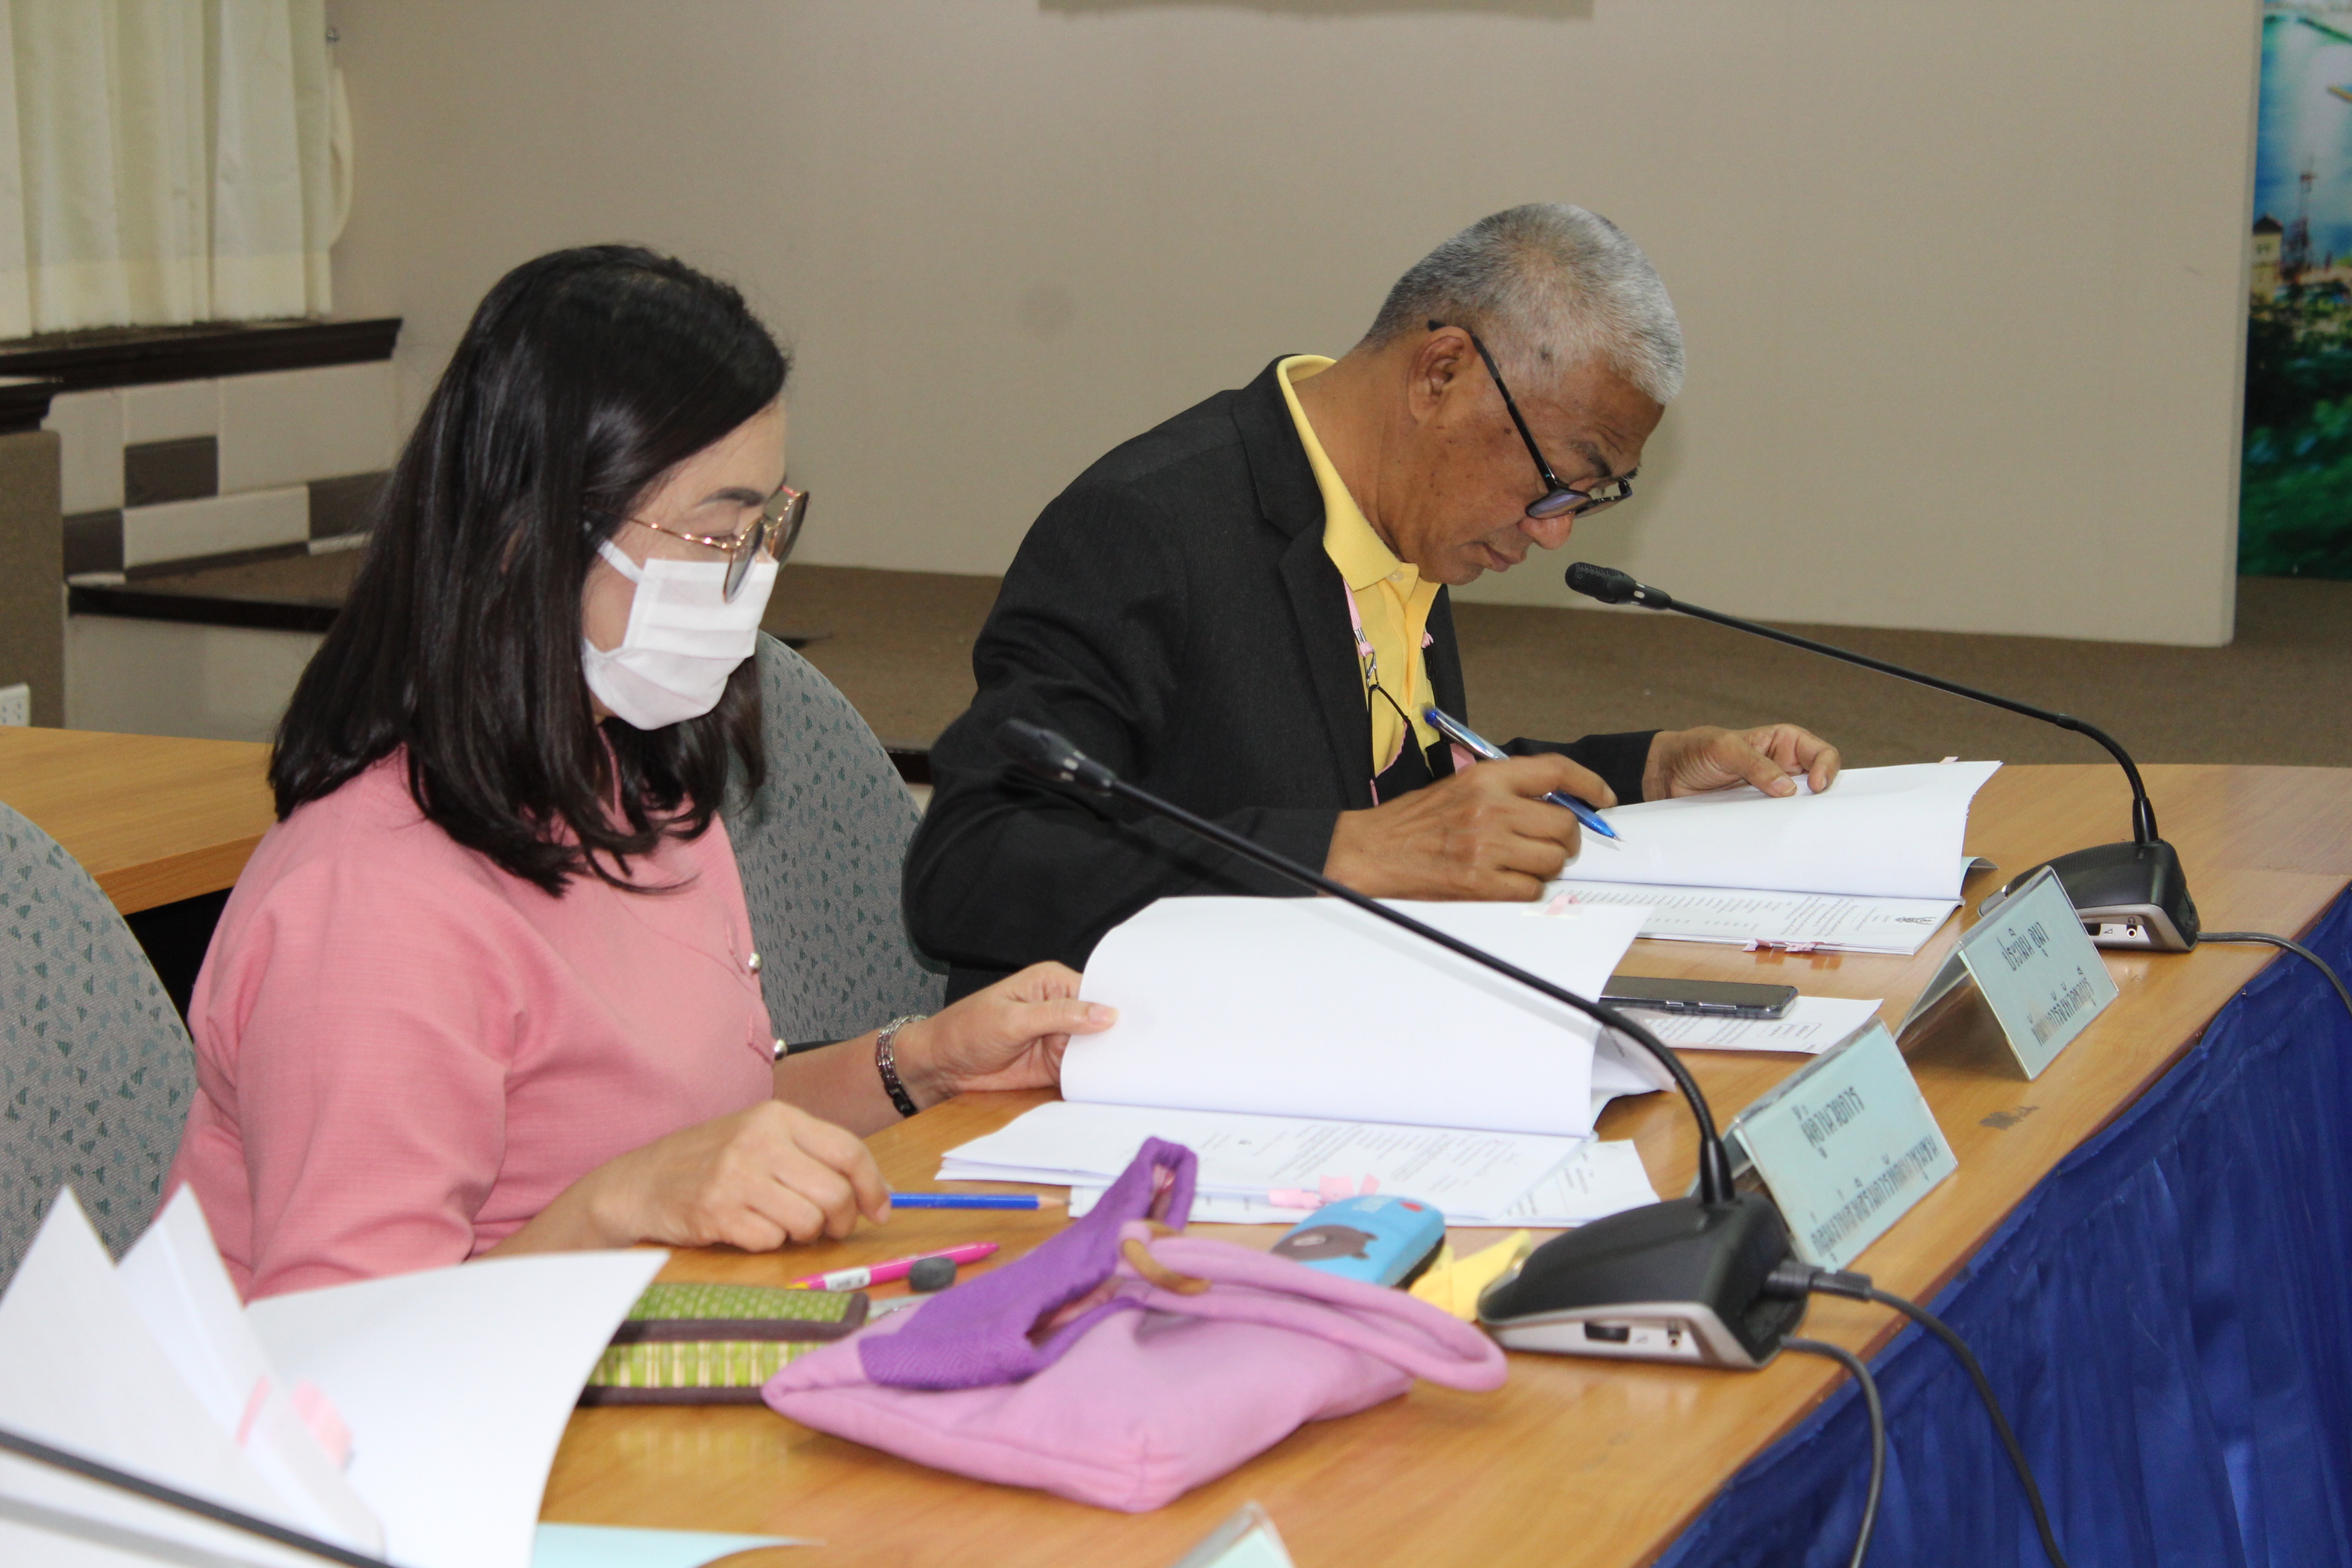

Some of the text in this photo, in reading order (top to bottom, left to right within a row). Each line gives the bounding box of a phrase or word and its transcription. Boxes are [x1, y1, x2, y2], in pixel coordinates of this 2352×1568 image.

[2028, 921, 2051, 958] อุมา
[2026, 965, 2097, 1047] พัฒาการจังหวัดชลบุรี
[1791, 1085, 1865, 1160] ผู้อำนวยการ
